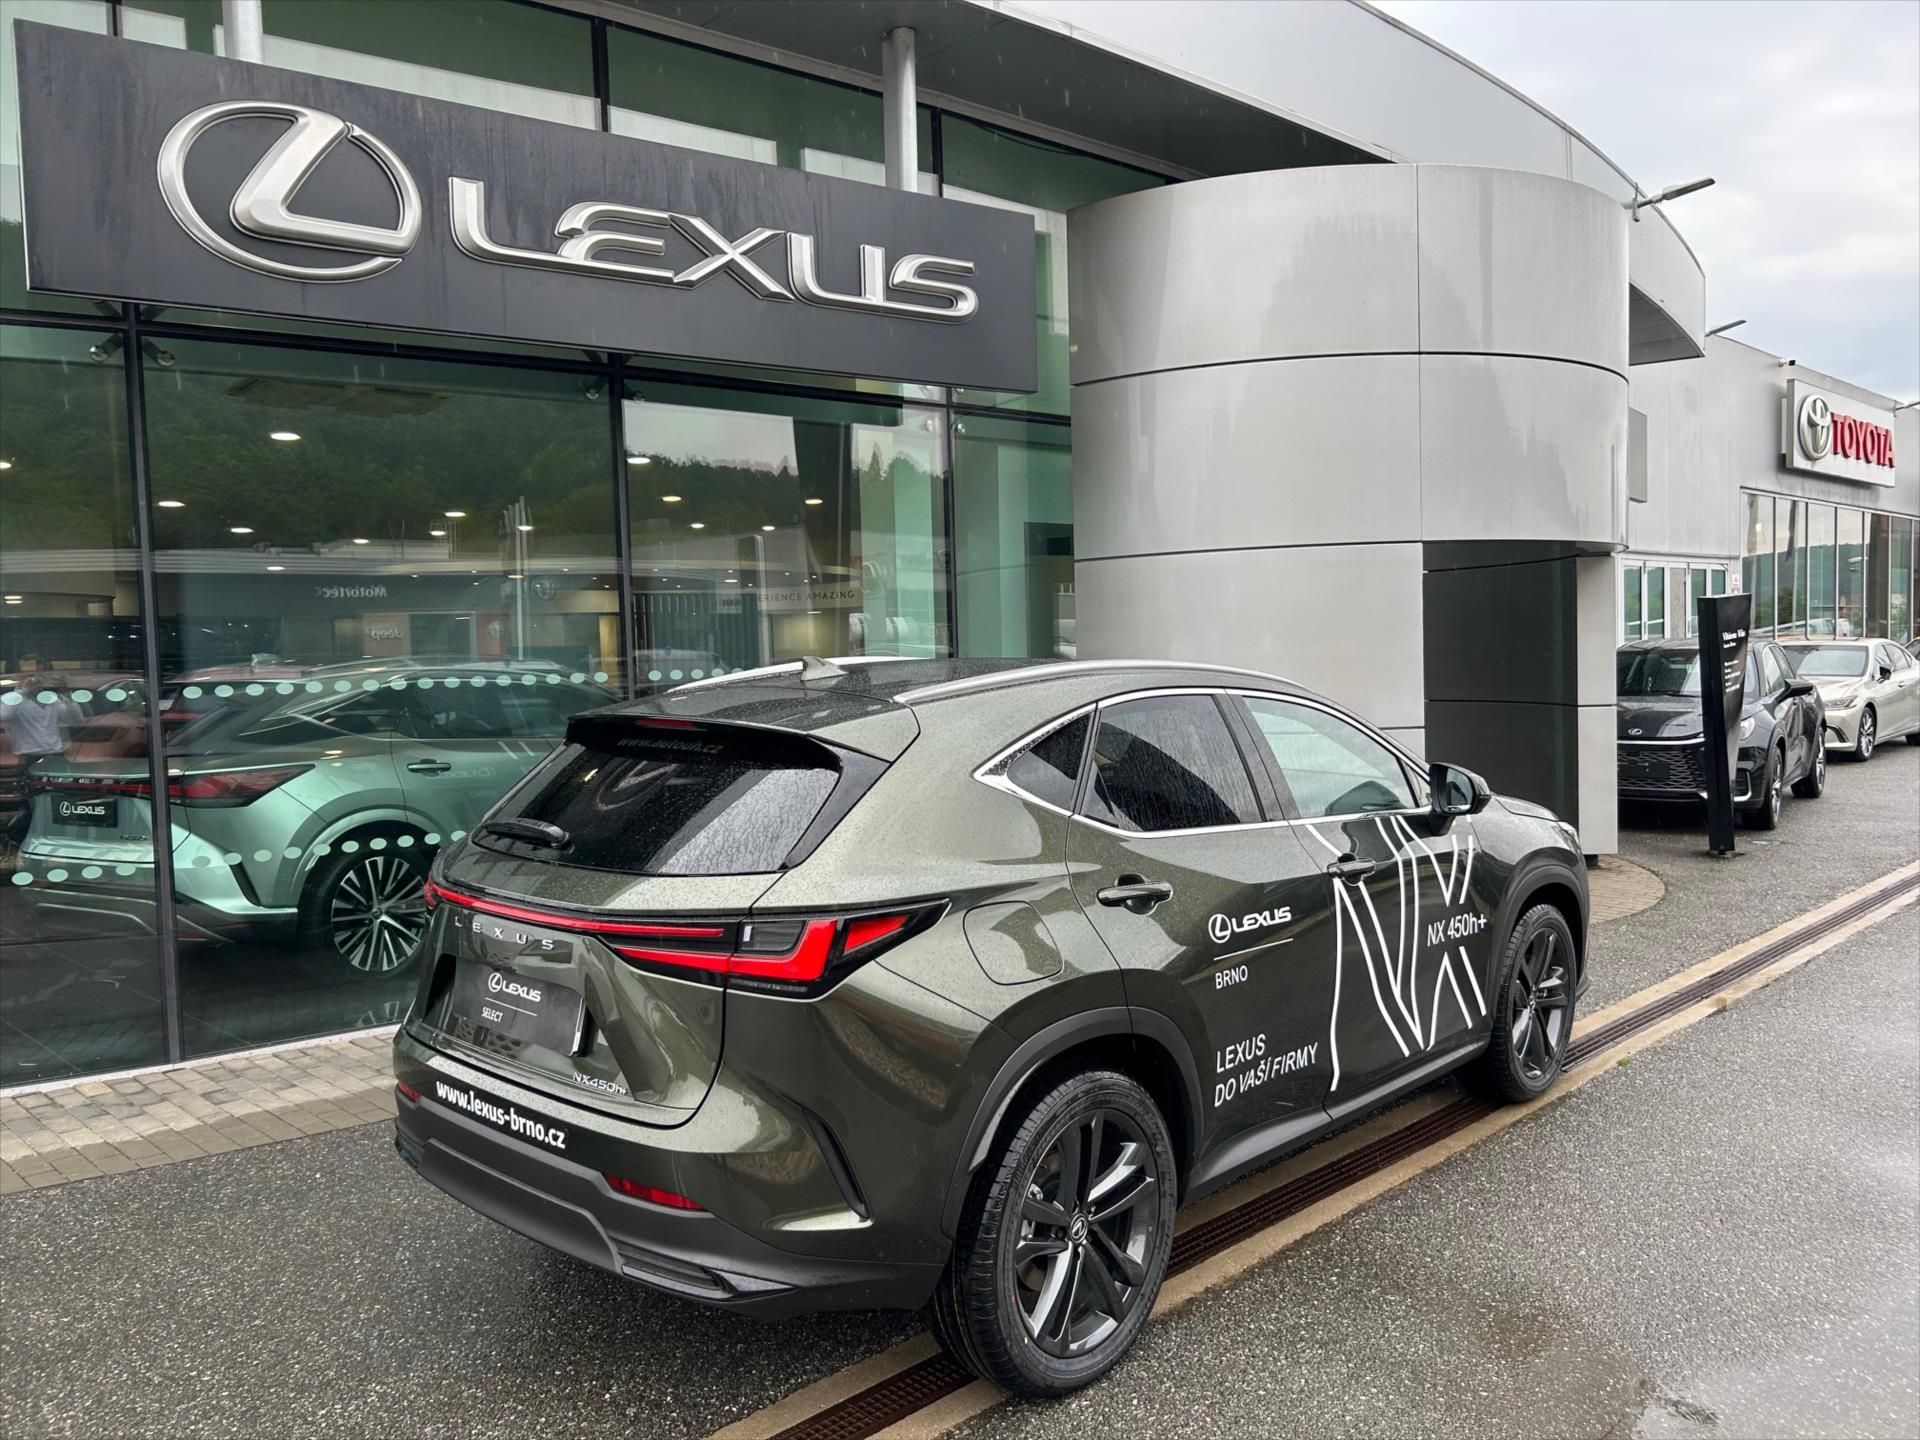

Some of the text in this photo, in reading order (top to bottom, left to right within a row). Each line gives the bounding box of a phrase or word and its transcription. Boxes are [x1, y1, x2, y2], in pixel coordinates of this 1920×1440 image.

[448, 176, 979, 325] LEXUS
[1830, 412, 1895, 468] TOYOTA
[72, 805, 105, 815] LEXUS
[454, 914, 554, 950] LEXUS
[1231, 906, 1292, 933] LEXUS
[1427, 912, 1488, 947] NX 450h+
[502, 981, 542, 1002] LEXUS
[1215, 965, 1248, 989] BRNO
[481, 1006, 503, 1023] SELECT
[1216, 1033, 1266, 1074] LEXUS
[1214, 1042, 1319, 1108] DO VAŠÍ FIRMY
[436, 1080, 567, 1150] www.lexus-brno.cz
